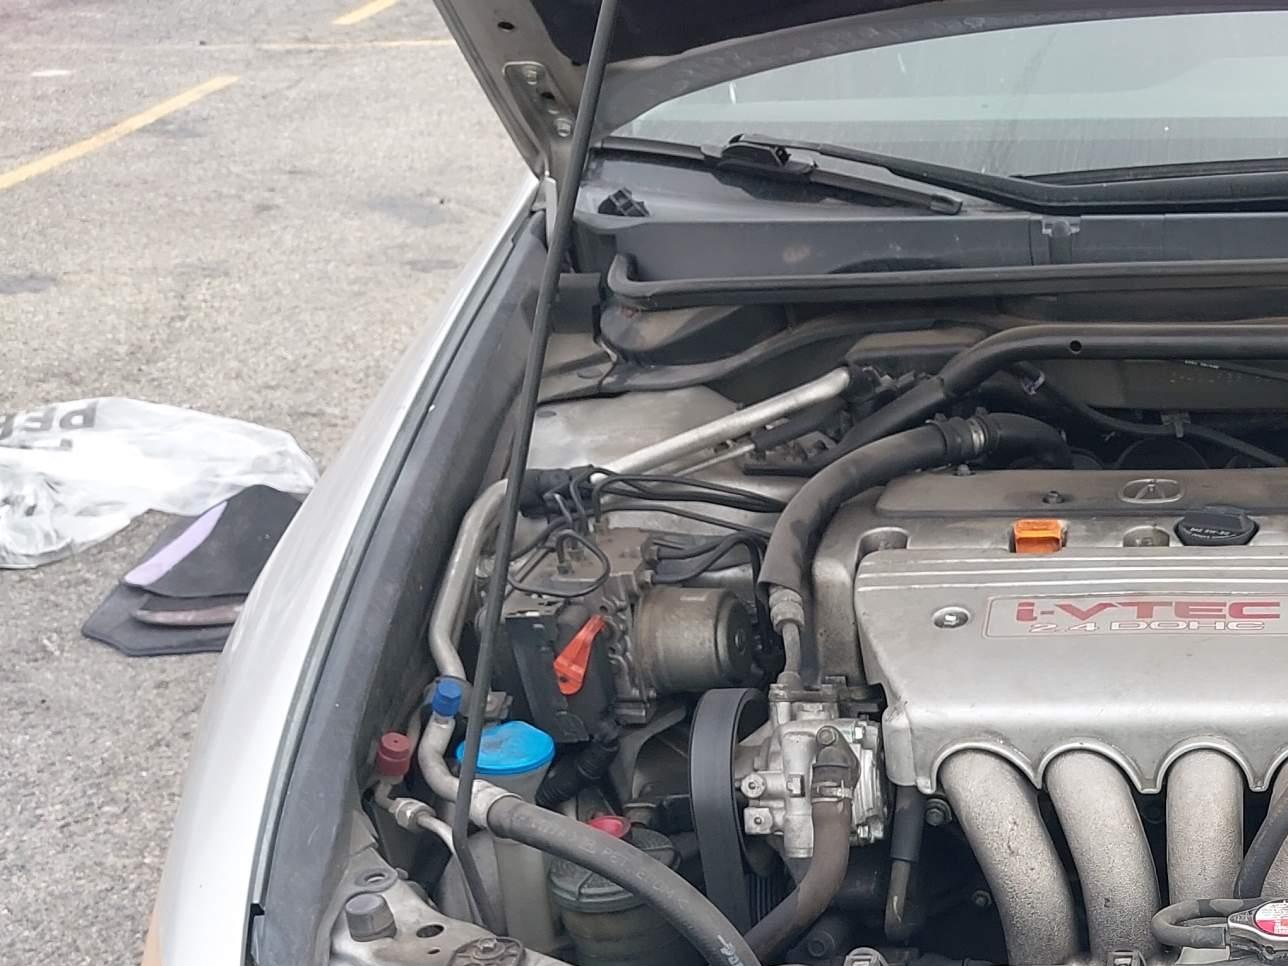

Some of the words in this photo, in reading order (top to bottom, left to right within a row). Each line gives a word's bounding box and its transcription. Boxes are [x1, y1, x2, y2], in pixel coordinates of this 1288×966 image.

[1016, 601, 1281, 622] i-VTEC
[1028, 623, 1099, 633] 2.4
[1110, 621, 1265, 631] DOHC
